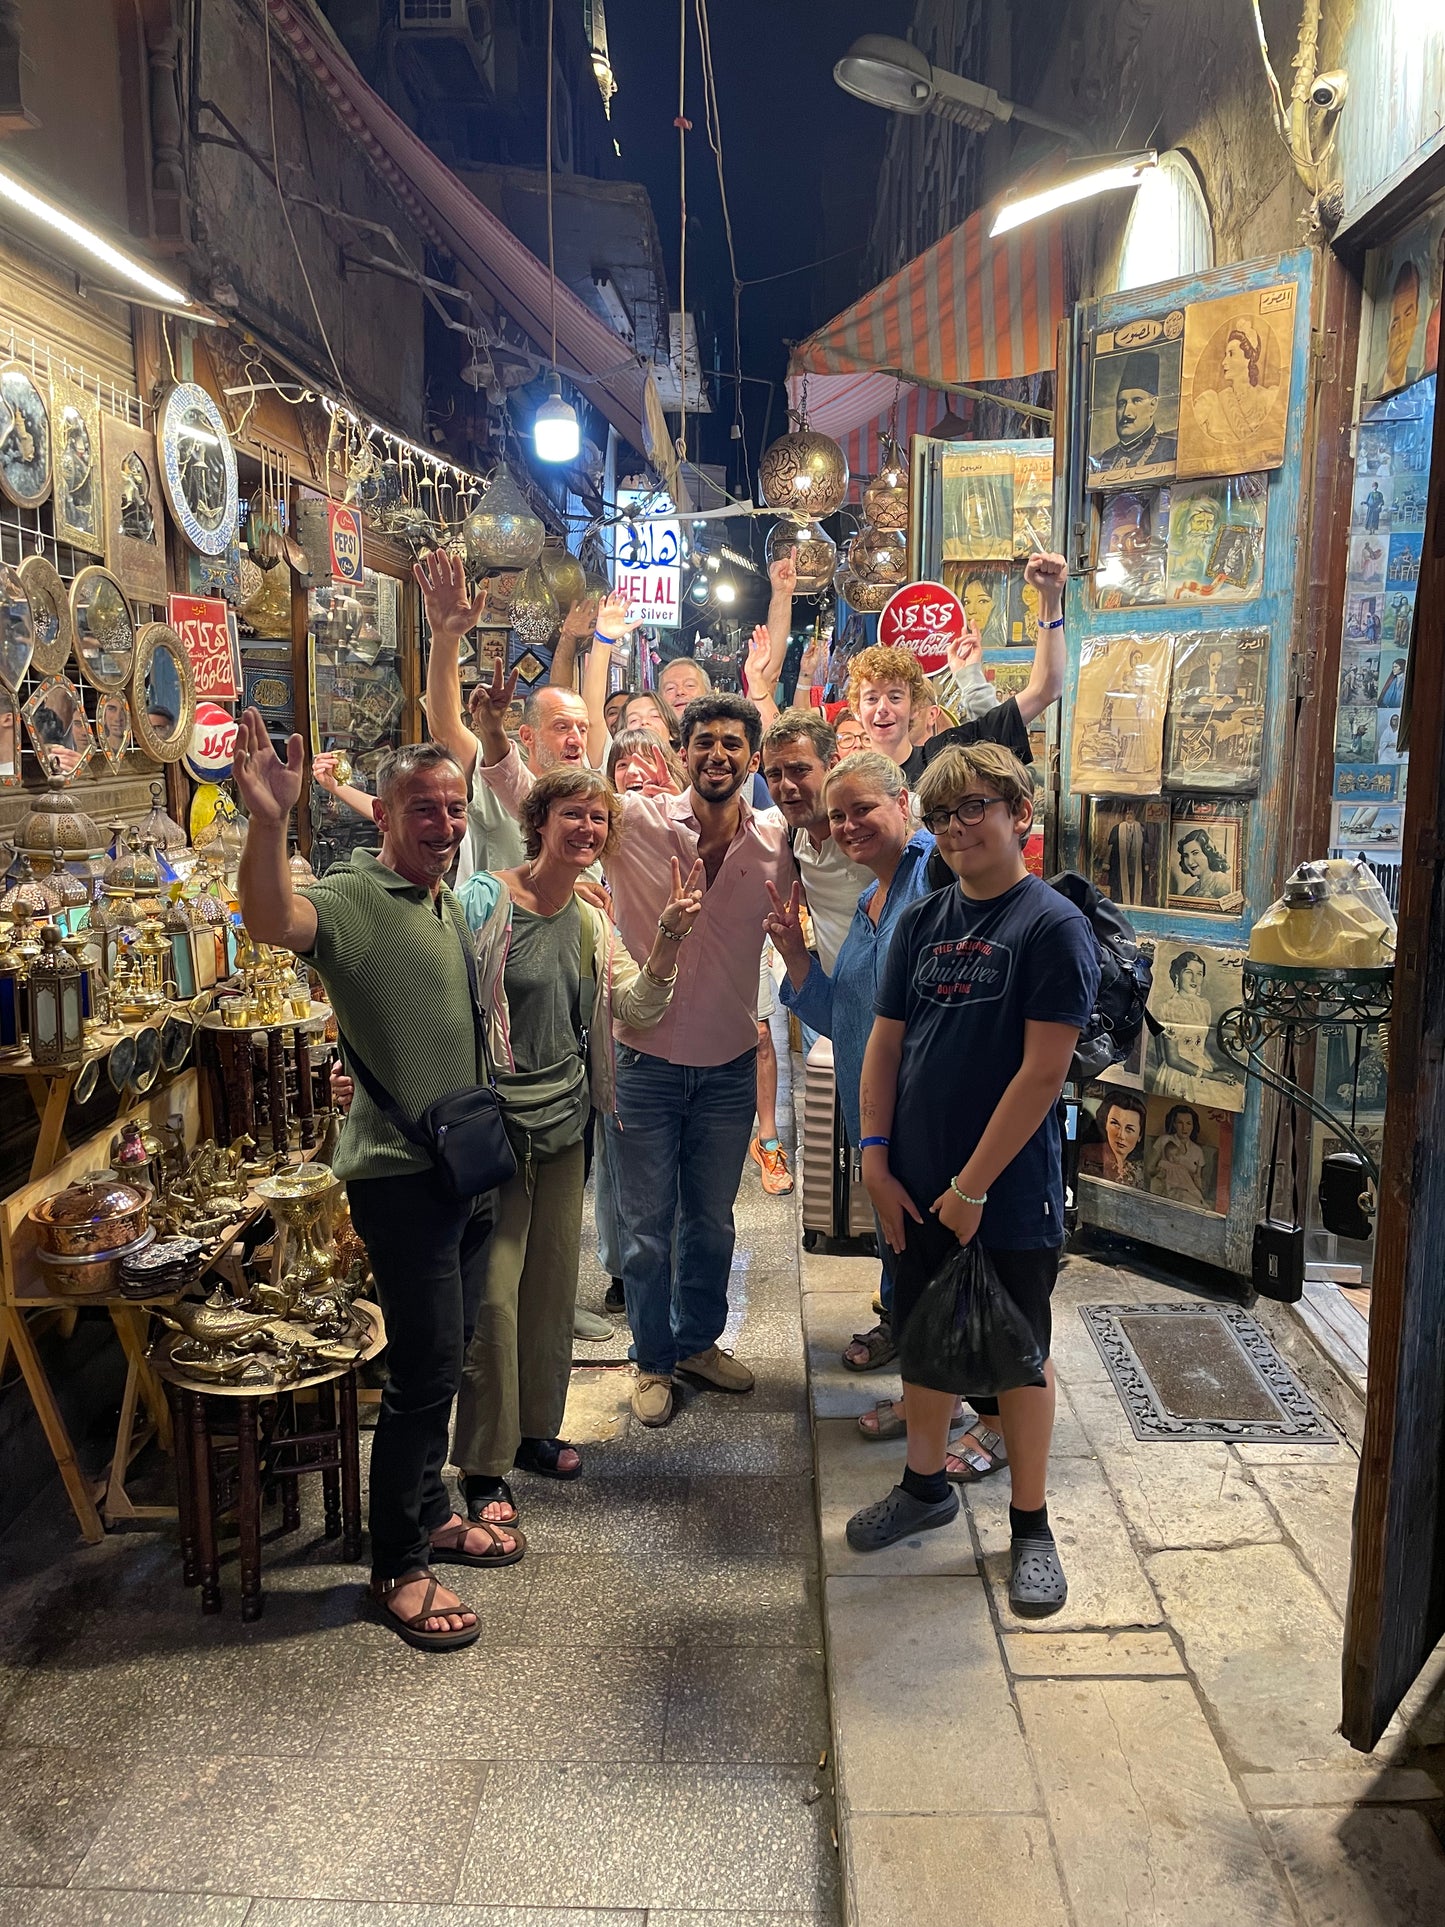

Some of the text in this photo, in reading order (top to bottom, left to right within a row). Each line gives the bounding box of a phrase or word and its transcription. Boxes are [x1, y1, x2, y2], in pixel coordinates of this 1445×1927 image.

[334, 531, 357, 556] PEPSI
[617, 574, 677, 605] HELAL
[640, 607, 674, 621] Silver
[933, 943, 954, 956] THE
[918, 956, 1000, 987] Quikilver
